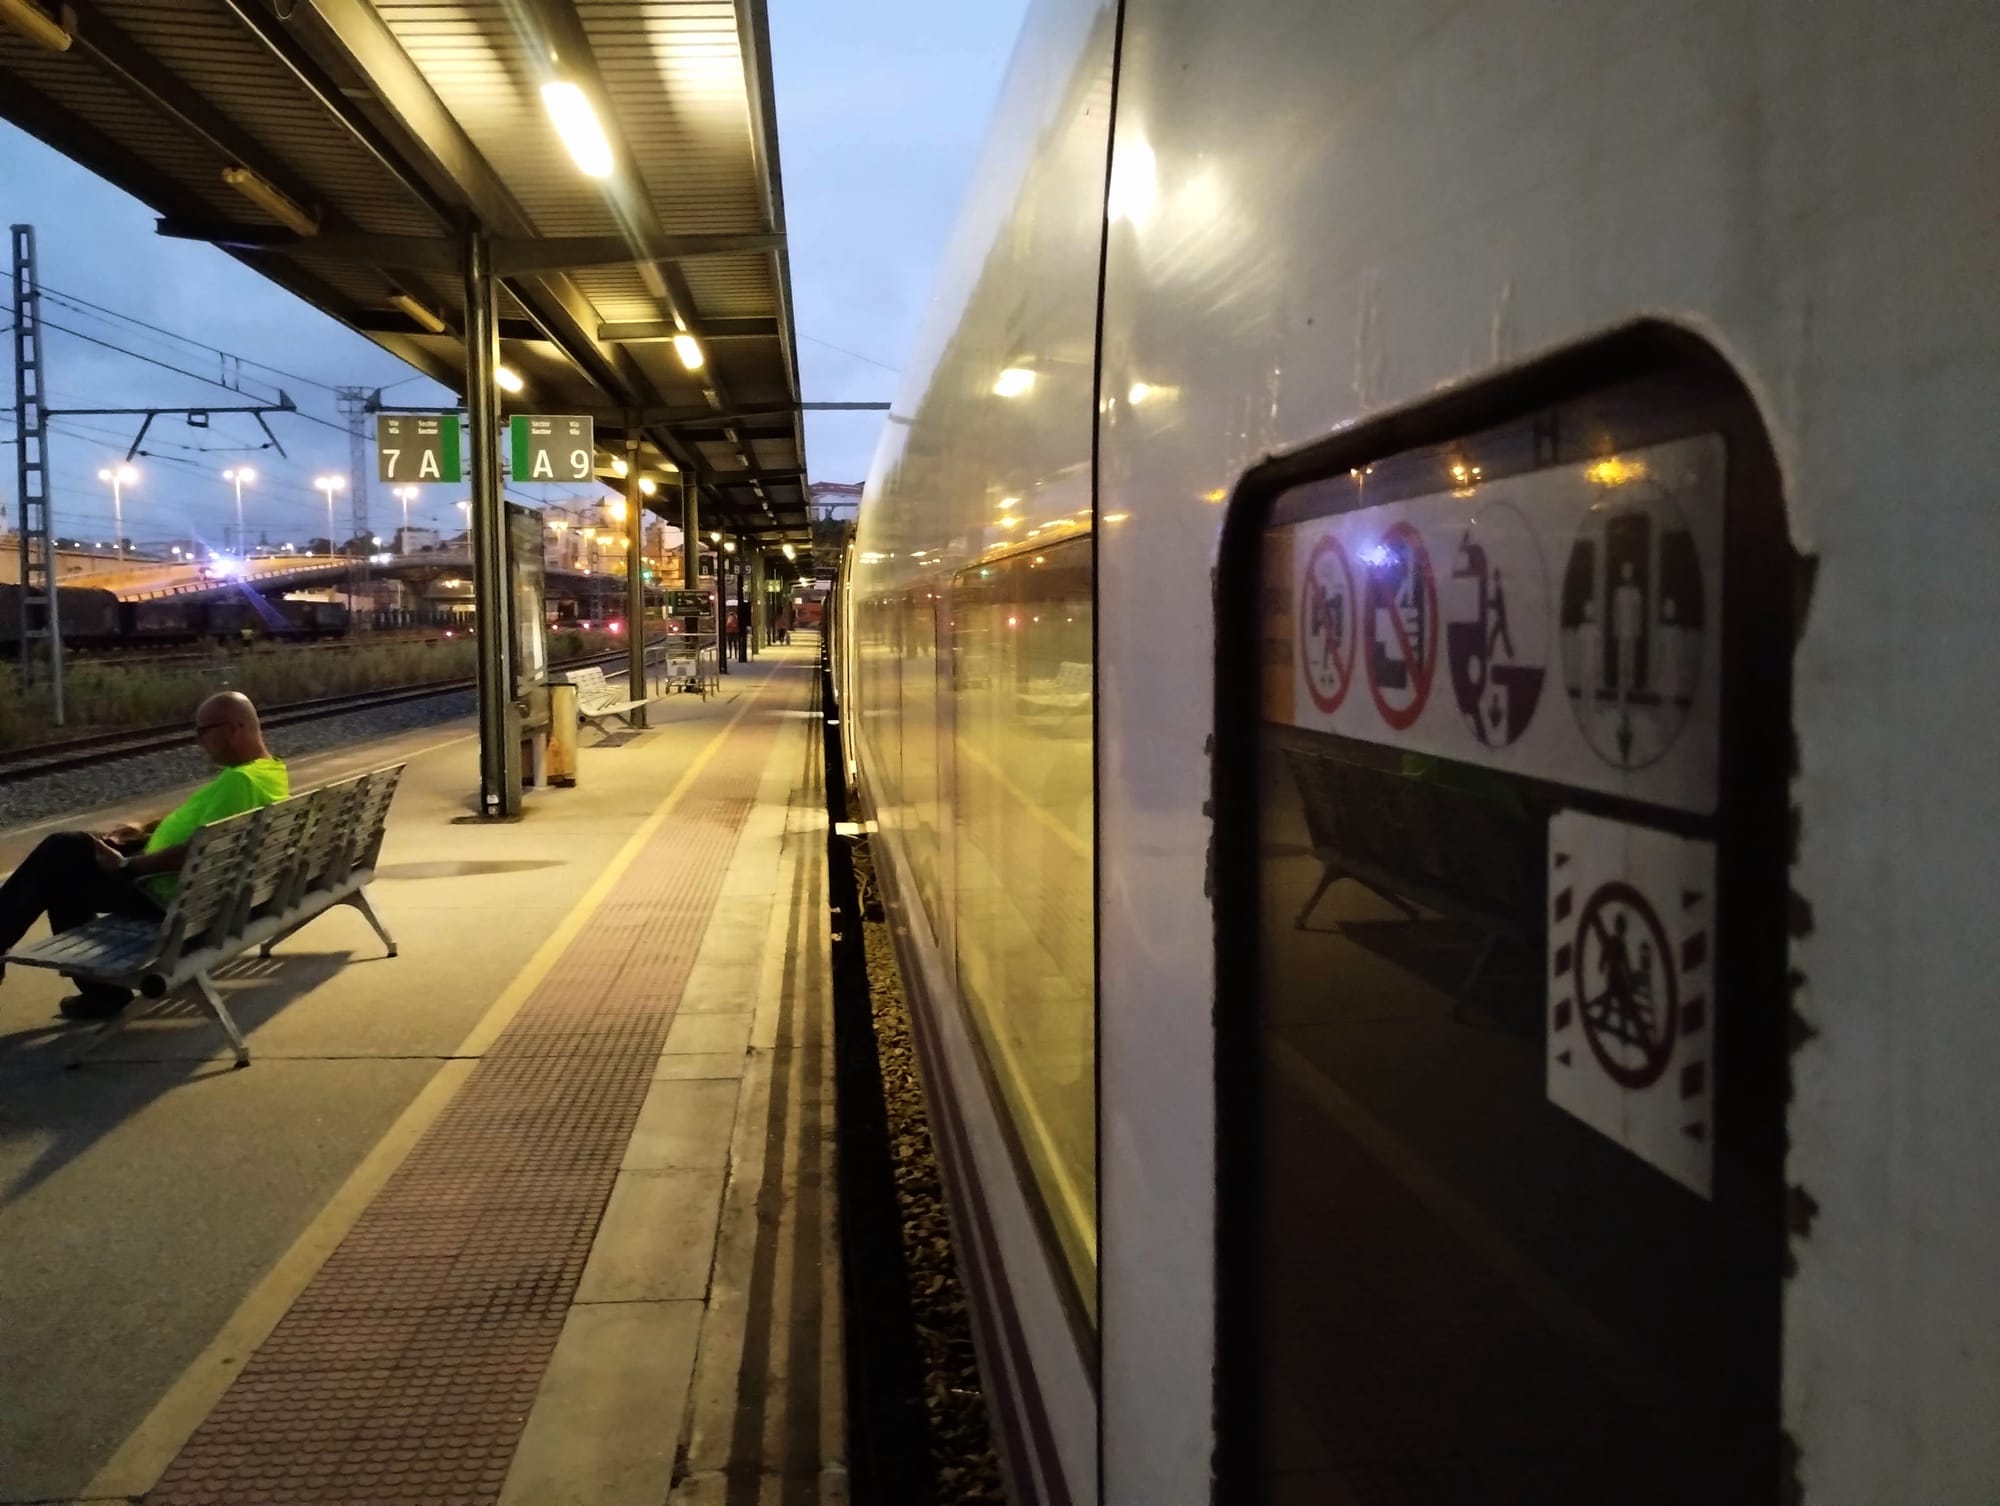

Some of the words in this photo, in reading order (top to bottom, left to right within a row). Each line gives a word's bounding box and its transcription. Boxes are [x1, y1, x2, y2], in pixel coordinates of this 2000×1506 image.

[382, 449, 401, 479] 7
[419, 449, 440, 478] A
[532, 449, 554, 478] A
[570, 449, 590, 479] 9
[745, 564, 752, 574] 9
